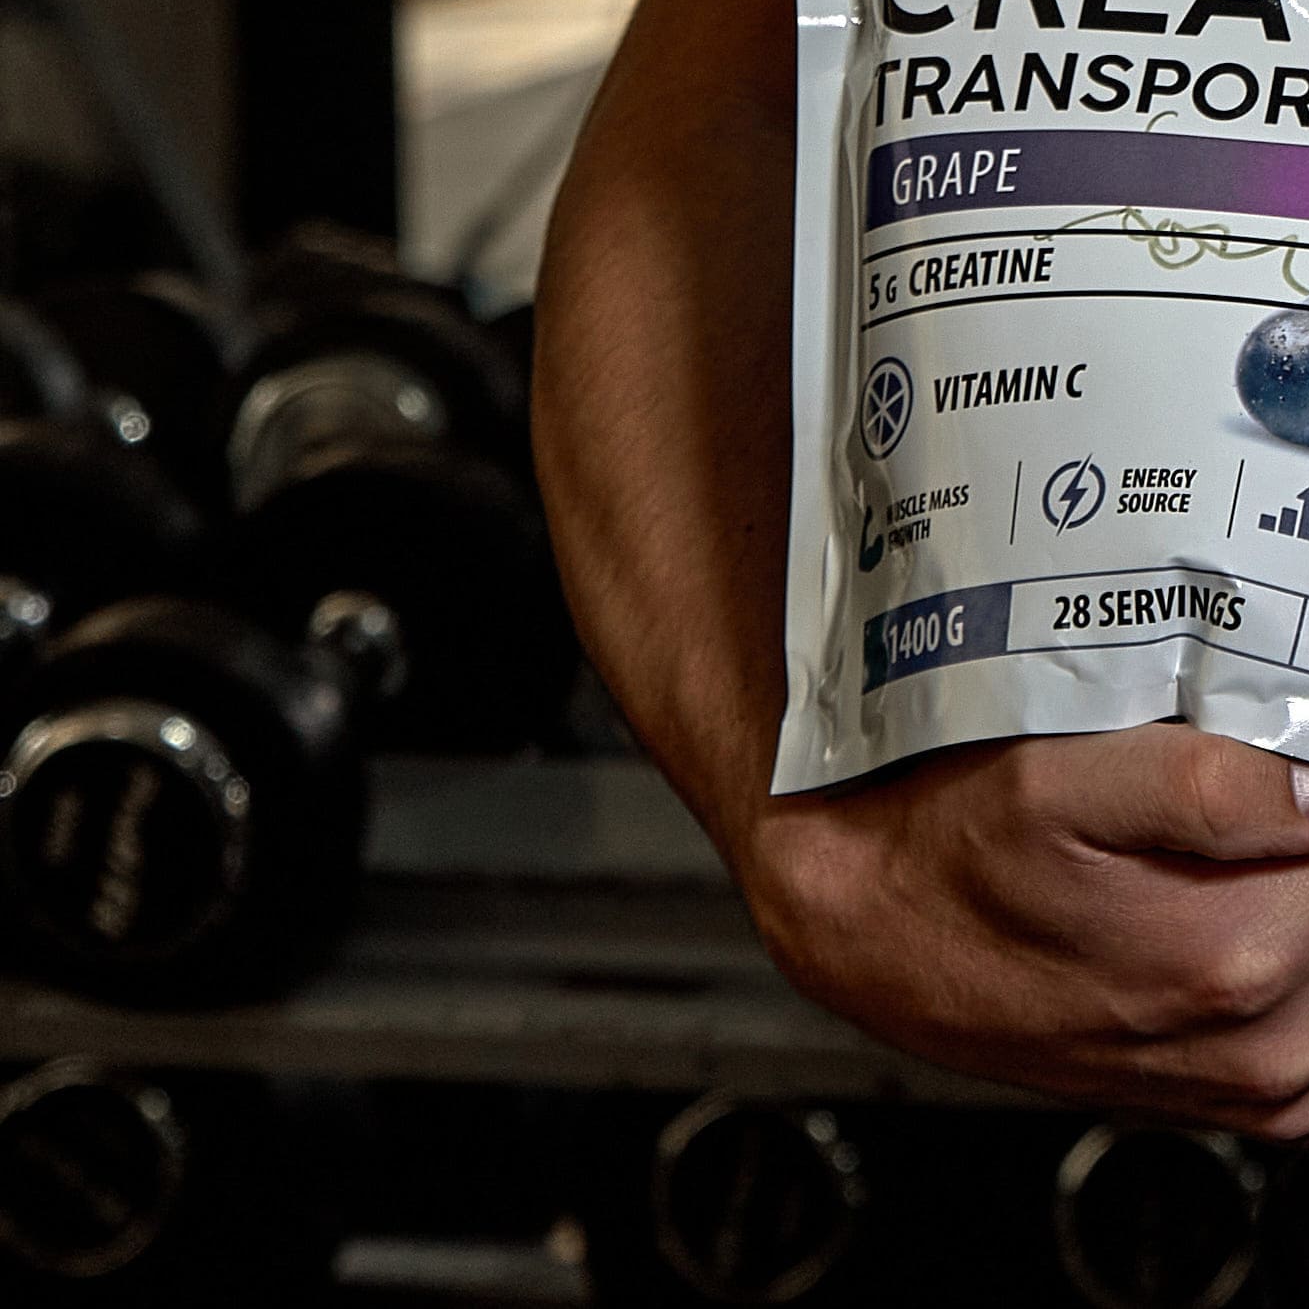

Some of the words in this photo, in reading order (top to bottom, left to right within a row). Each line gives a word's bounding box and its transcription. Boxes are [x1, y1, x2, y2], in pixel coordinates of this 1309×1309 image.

[890, 146, 1022, 206] GRAPE
[908, 246, 1055, 297] CREATINE
[933, 364, 1059, 414] VITAMIN
[1065, 362, 1088, 399] C
[929, 483, 970, 512] MASS
[1120, 466, 1198, 490] ENERGY
[1116, 491, 1192, 516] SOURCE
[1051, 593, 1092, 631] 28
[1097, 584, 1248, 632] SERVINGS
[884, 613, 941, 665] 1400
[946, 605, 965, 648] G
